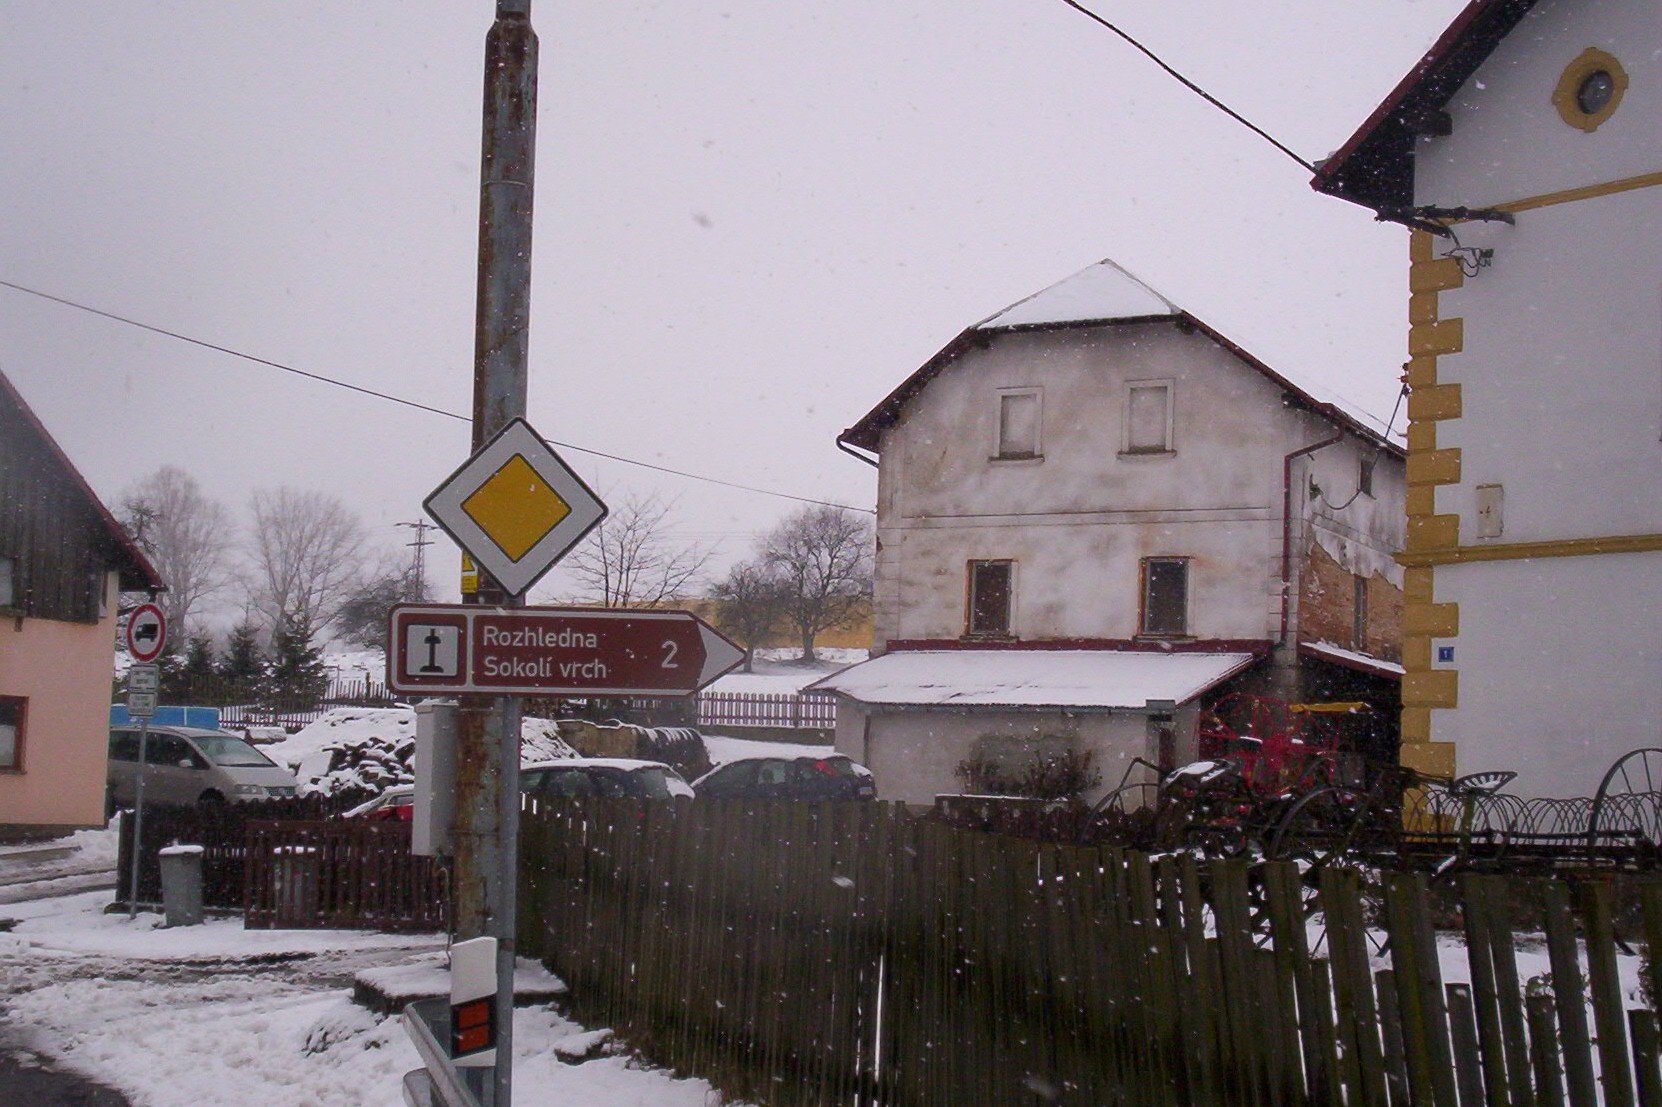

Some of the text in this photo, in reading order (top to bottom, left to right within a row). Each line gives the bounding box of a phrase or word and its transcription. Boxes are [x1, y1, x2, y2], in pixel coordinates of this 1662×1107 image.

[482, 625, 598, 648] Rozhledna
[660, 639, 679, 669] 2
[483, 655, 607, 679] Sokolí vrch
